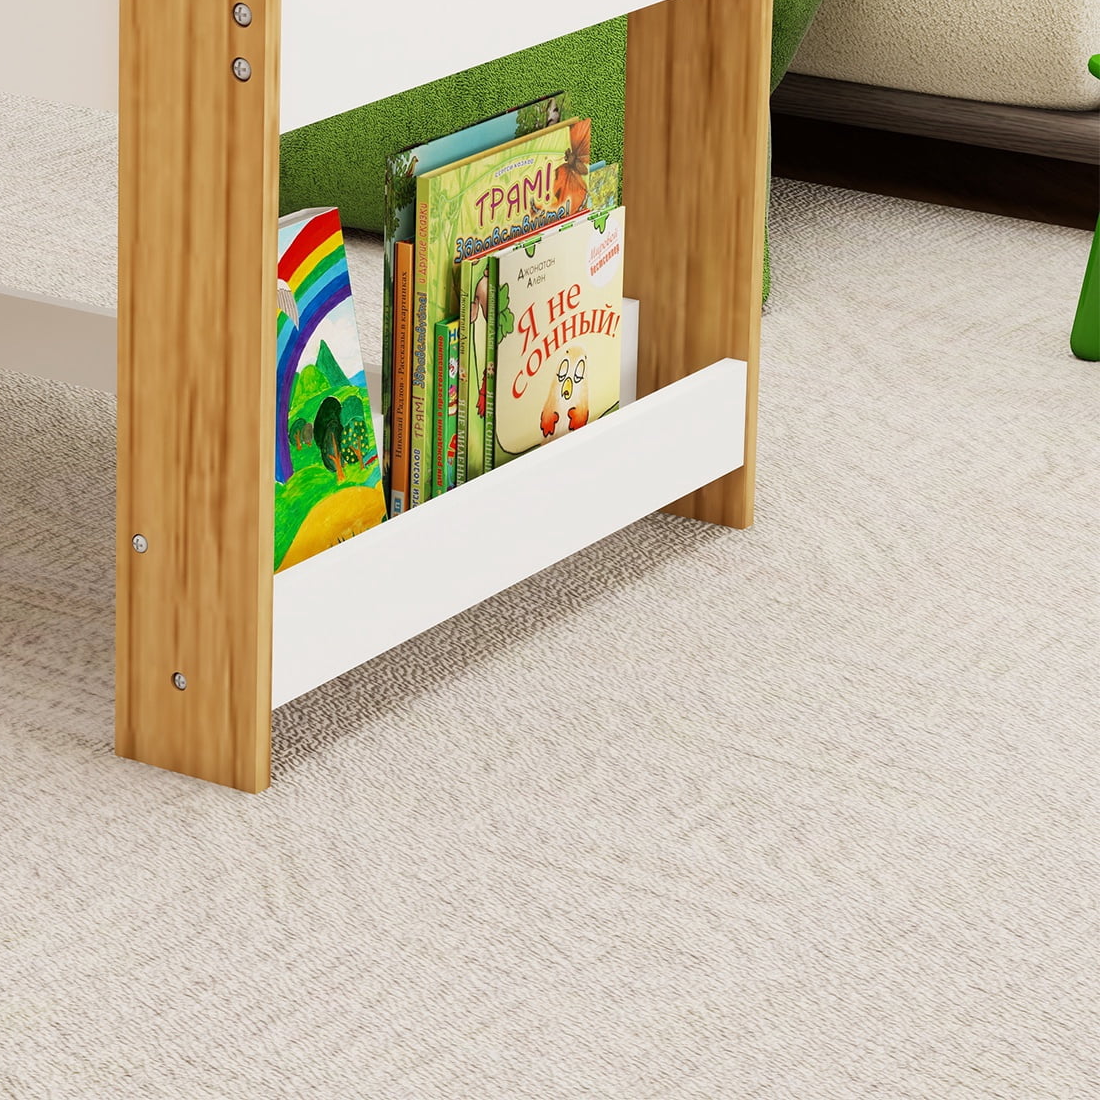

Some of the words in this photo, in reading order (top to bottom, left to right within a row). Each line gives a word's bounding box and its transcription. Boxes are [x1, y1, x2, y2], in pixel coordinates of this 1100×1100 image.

[476, 162, 552, 227] ТРЯМ!
[517, 258, 556, 281] Джонатан
[527, 274, 546, 289] Ален
[400, 270, 409, 322] картинках
[517, 302, 540, 356] Я
[547, 283, 581, 324] не
[398, 331, 407, 375] Рассказы
[511, 303, 621, 399] сонный!
